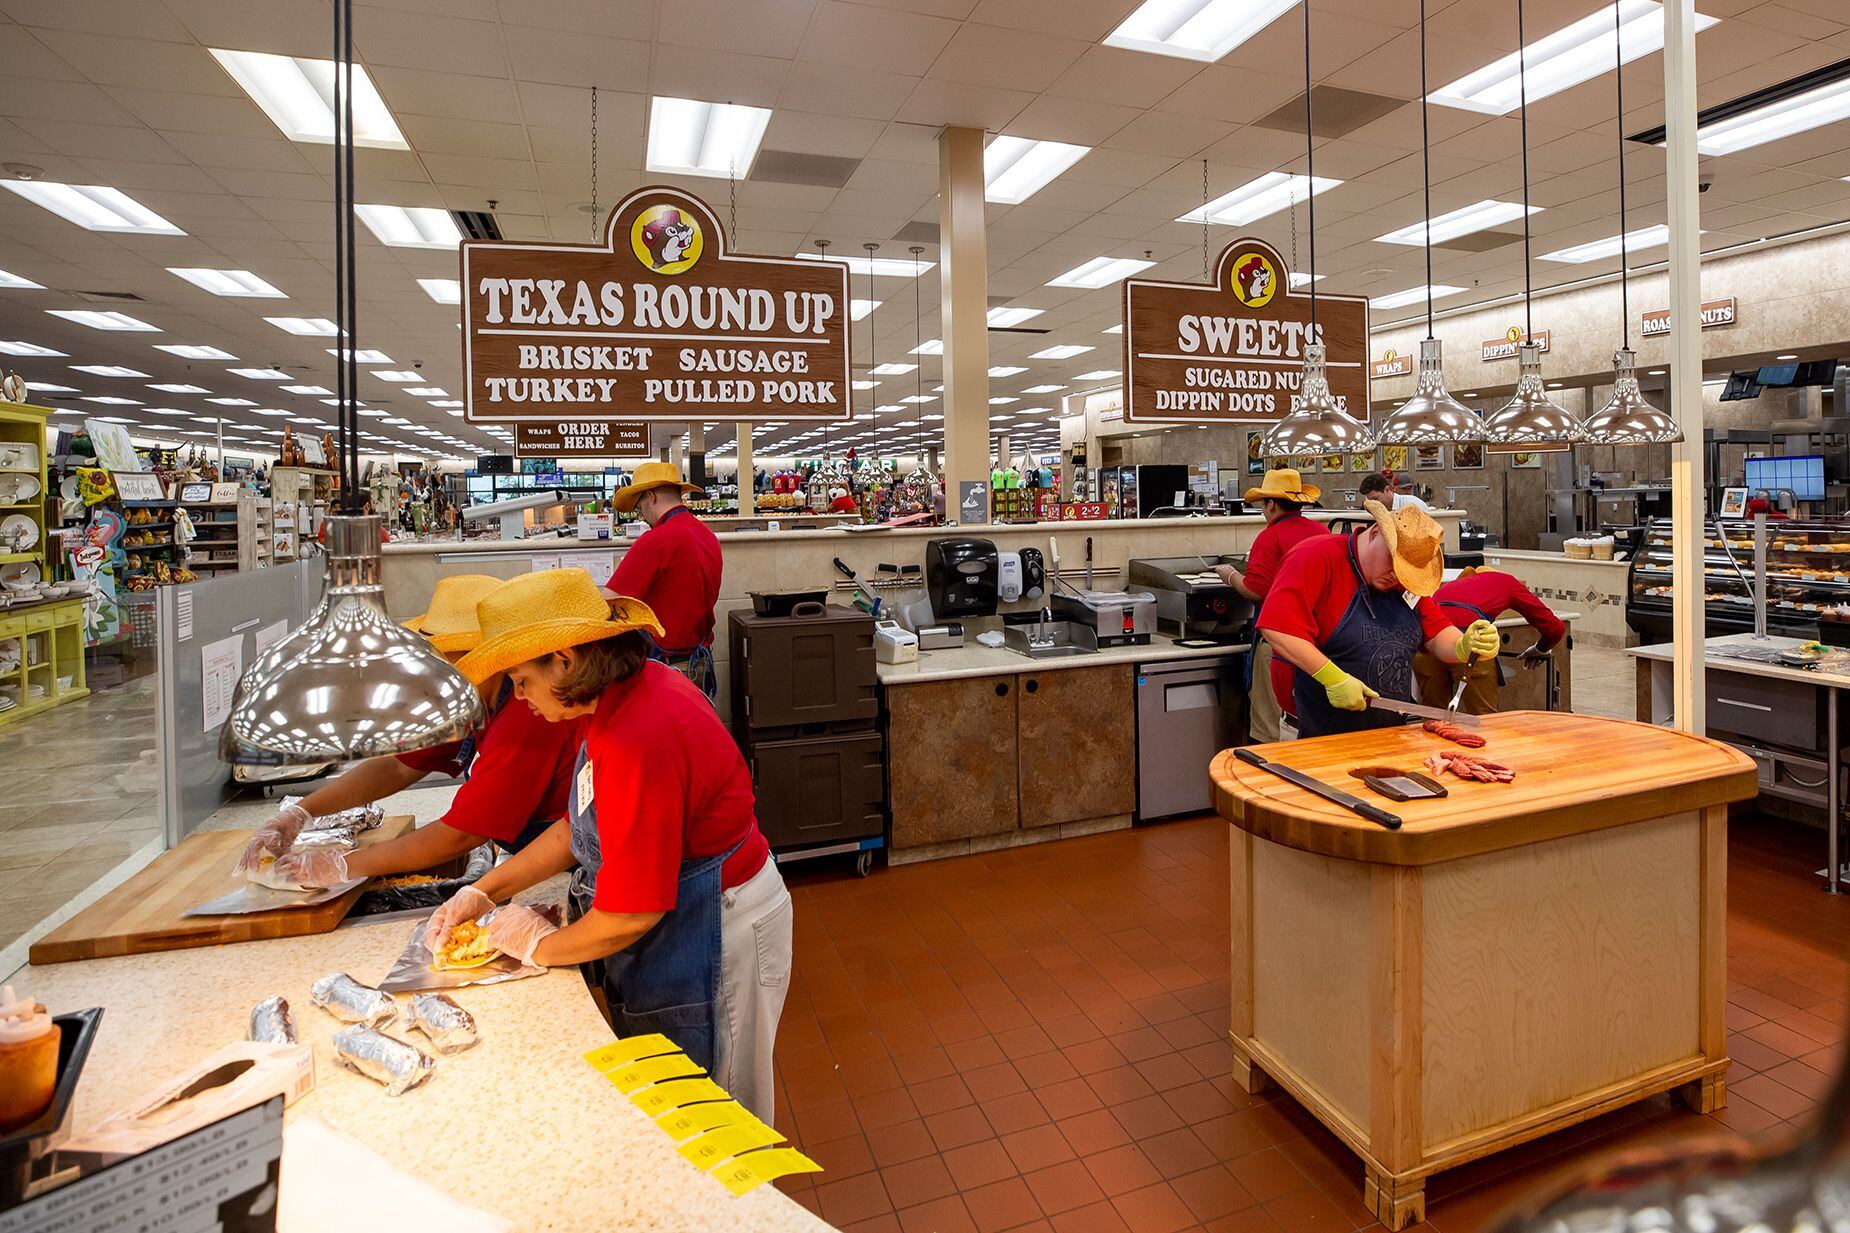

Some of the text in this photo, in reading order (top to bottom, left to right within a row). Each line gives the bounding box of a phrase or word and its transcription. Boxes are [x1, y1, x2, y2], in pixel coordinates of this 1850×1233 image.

[479, 277, 835, 335] TEXAS ROUND UP
[1643, 316, 1670, 333] ROAS
[518, 345, 809, 374] BRISKET SAUSAGE
[1375, 361, 1402, 374] WRAPS
[1185, 367, 1304, 391] SUGARED NU
[485, 378, 837, 405] TURKEY PULLED PORK
[1155, 391, 1226, 412] DIPPIN'
[1228, 393, 1276, 414] DOTS
[557, 423, 611, 436] ORDER
[563, 436, 605, 449] HERE
